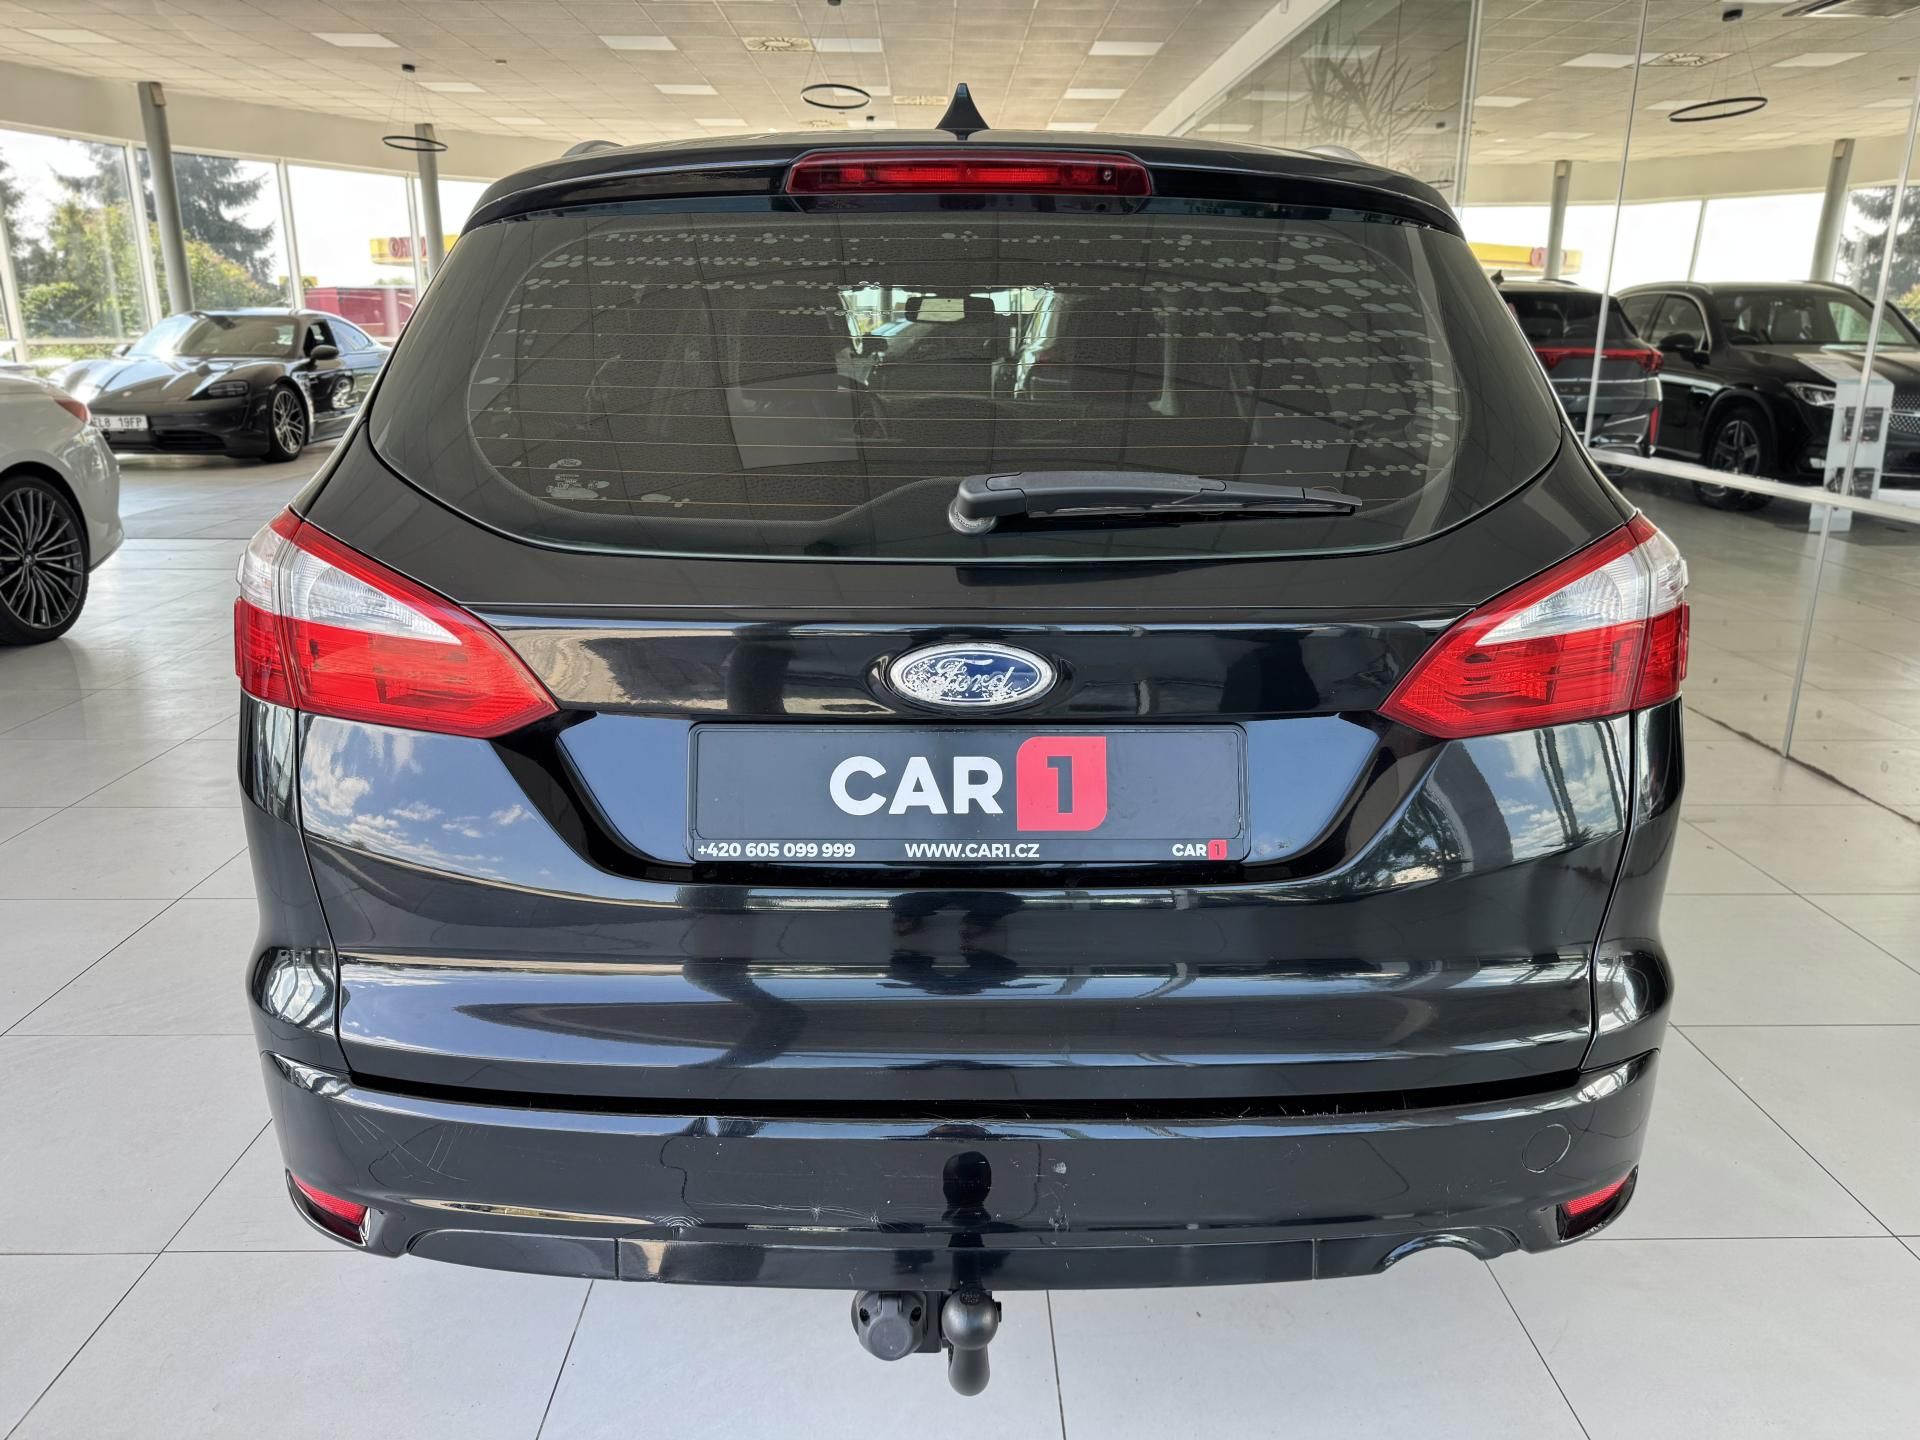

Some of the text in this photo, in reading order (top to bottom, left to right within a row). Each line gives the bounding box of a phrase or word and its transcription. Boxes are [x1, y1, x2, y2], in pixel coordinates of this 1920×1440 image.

[928, 657, 1016, 693] Ford
[829, 755, 1004, 816] CAR
[697, 842, 856, 858] +420 605 099 999
[904, 843, 1040, 858] WWW.CAR1.CZ
